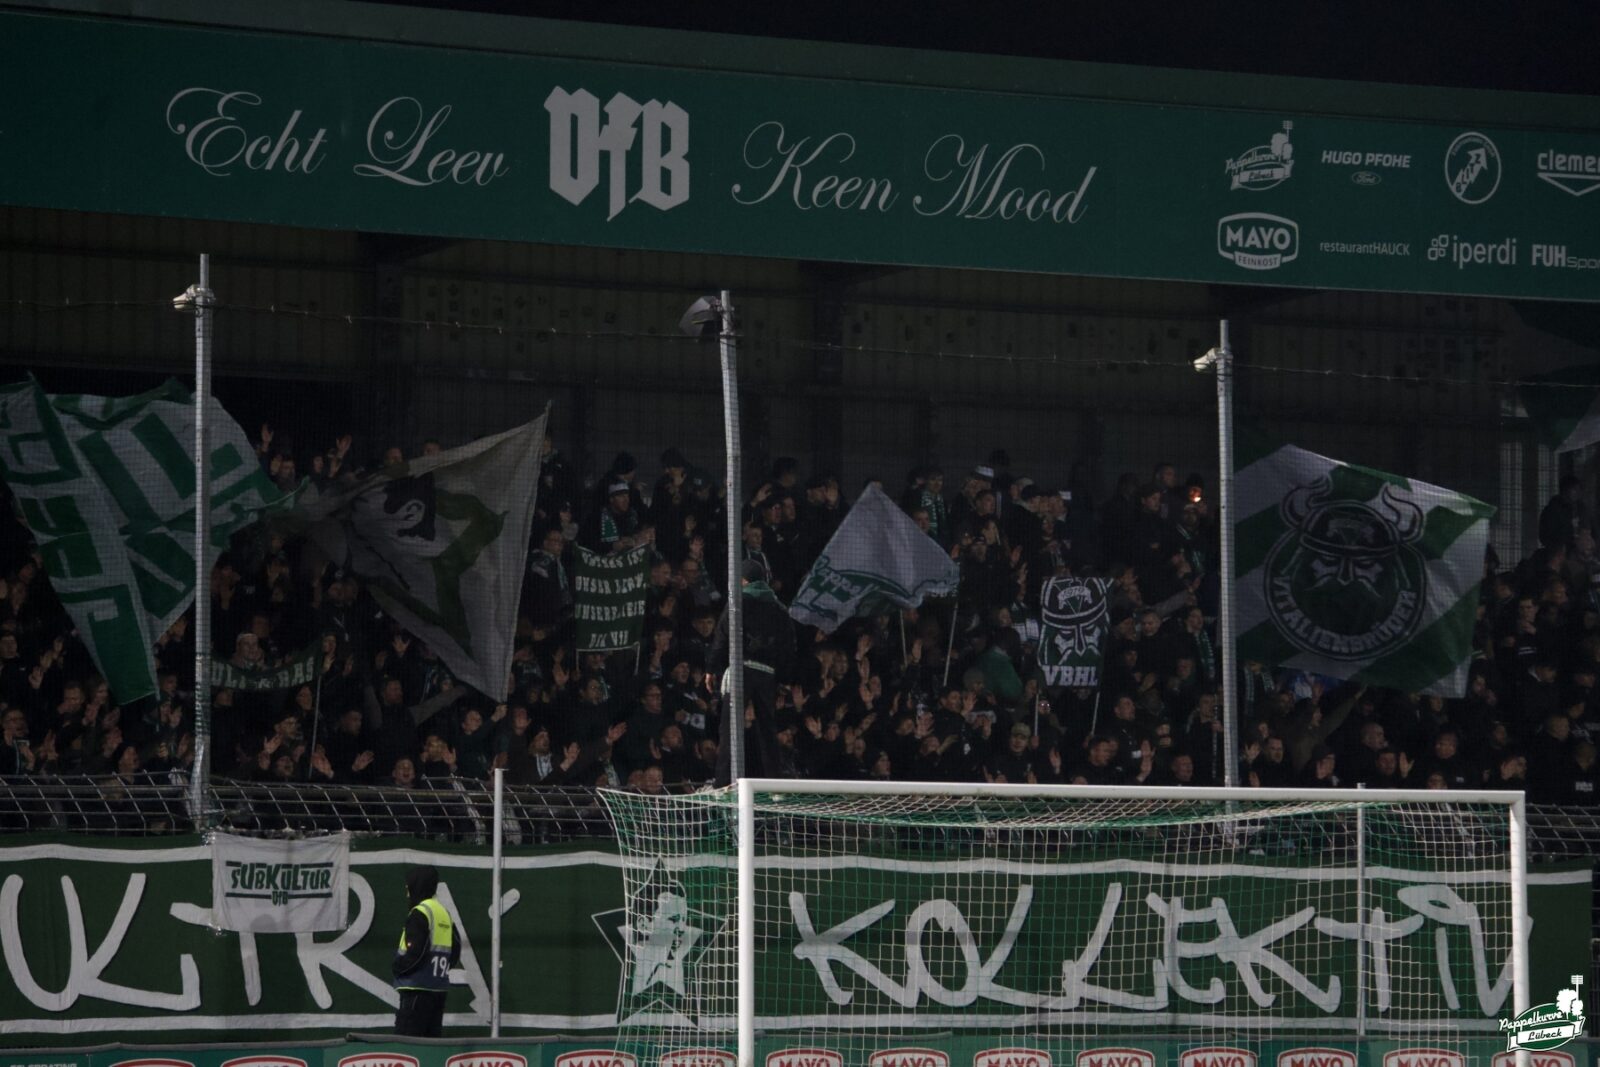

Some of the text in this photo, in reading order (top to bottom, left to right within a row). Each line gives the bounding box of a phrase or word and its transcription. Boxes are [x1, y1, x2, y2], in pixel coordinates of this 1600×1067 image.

[166, 86, 329, 178] Echt
[731, 121, 900, 212] Keen
[912, 134, 1098, 224] Mood
[1321, 149, 1412, 169] HUGO PFOHE
[1454, 152, 1482, 194] BLITZ
[1225, 225, 1292, 251] MAYO
[1319, 241, 1411, 257] restaurantHAUCK
[1238, 254, 1280, 267] FEINKOST
[1452, 234, 1518, 270] iperdi
[1041, 664, 1099, 687] VBHL
[231, 863, 332, 891] SUBKULTUR
[789, 882, 1534, 1016] KOLLEKTIV
